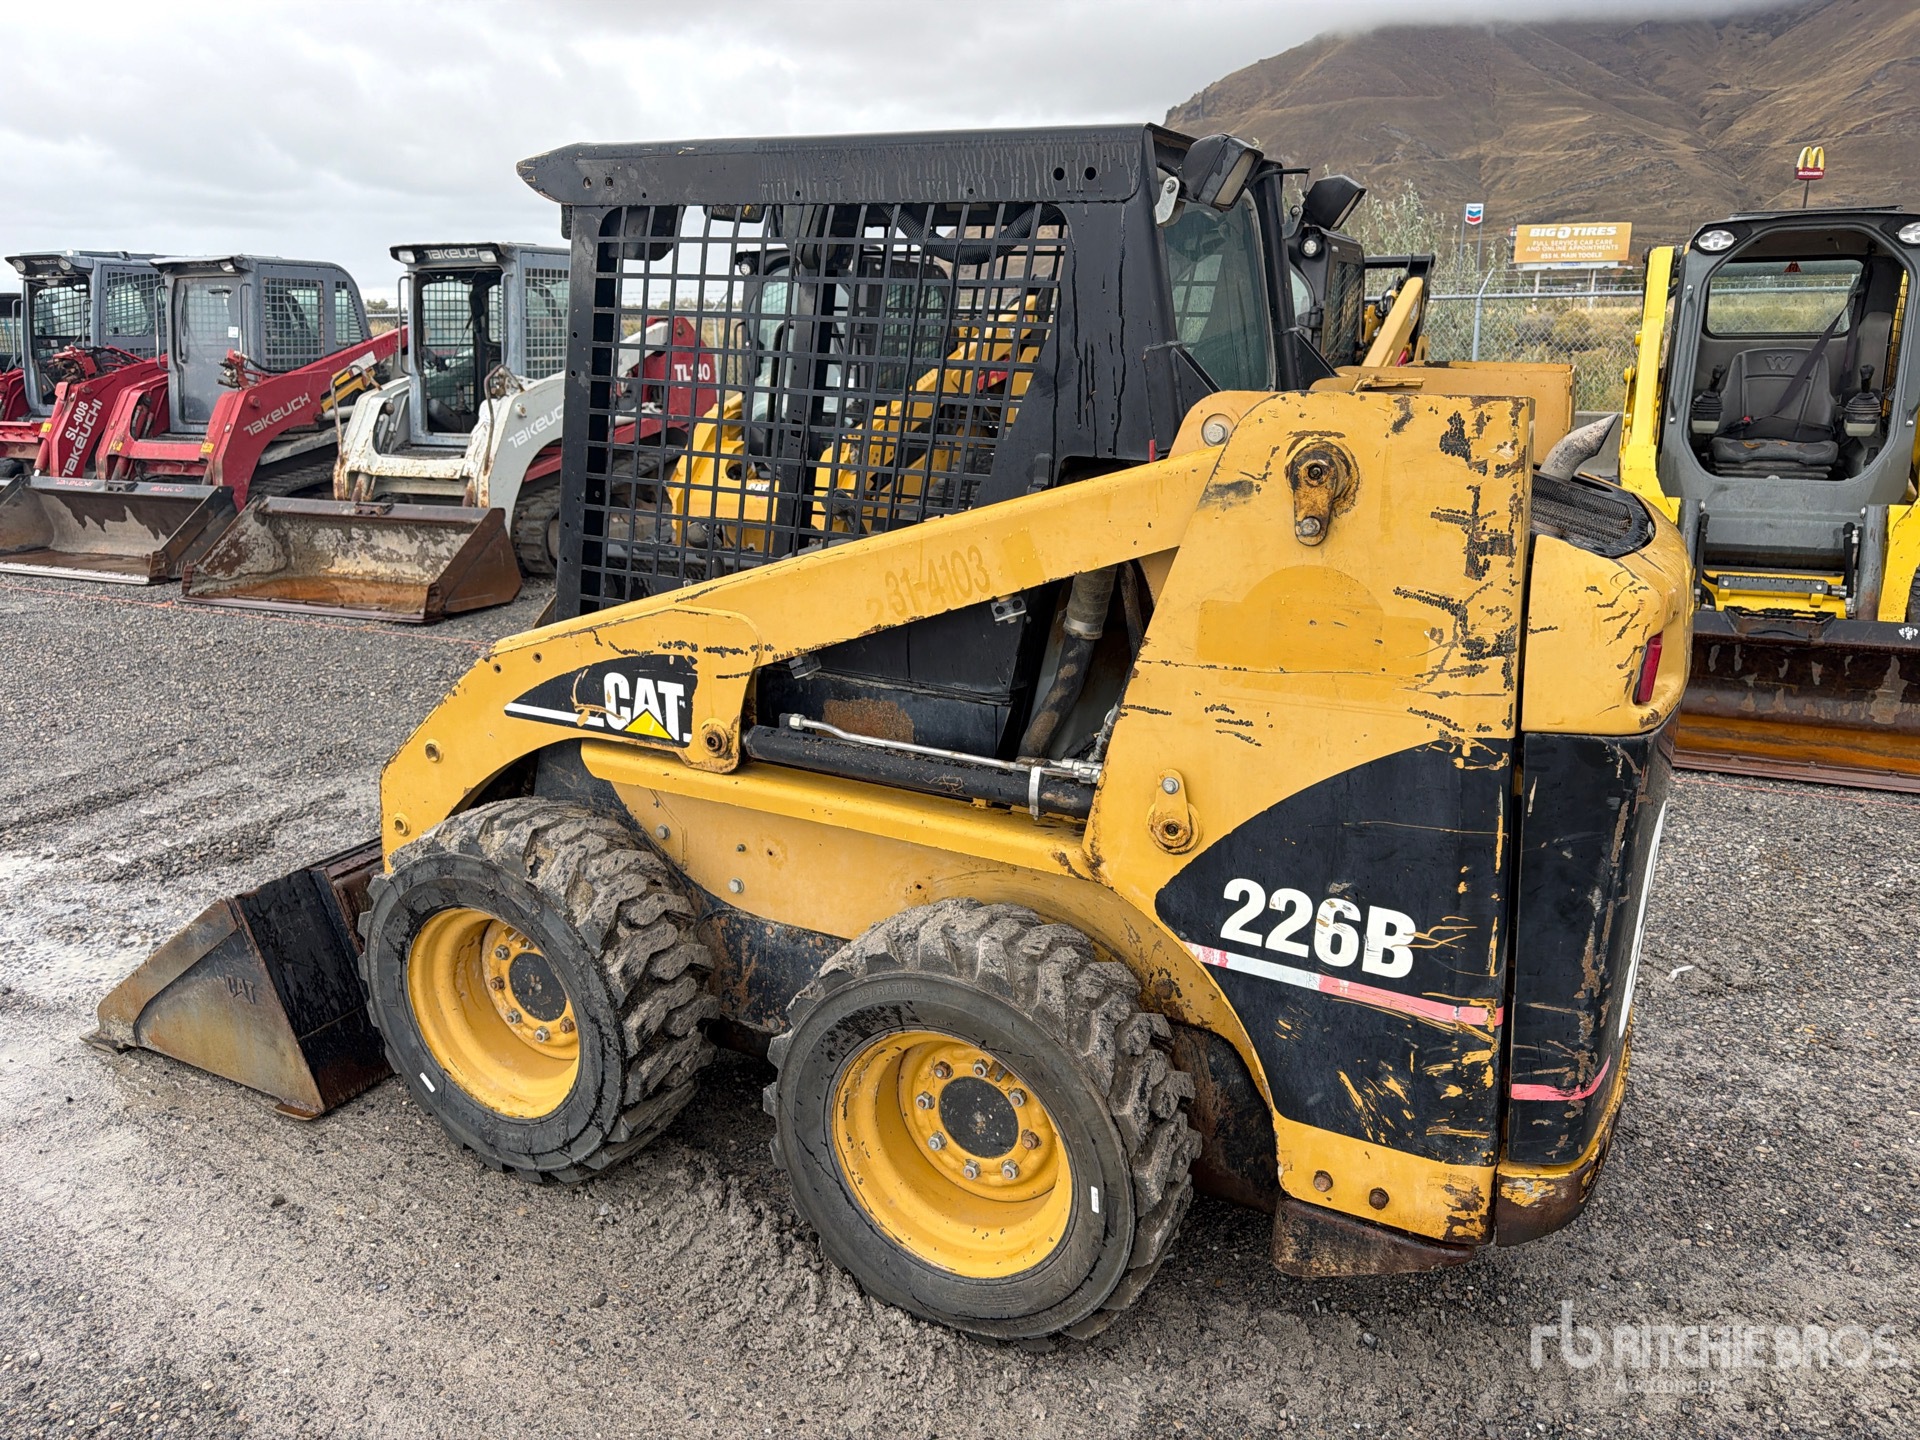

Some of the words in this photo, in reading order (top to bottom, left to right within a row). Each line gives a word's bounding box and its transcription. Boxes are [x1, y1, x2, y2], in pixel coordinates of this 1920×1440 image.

[1529, 227, 1557, 237] BIG
[1572, 226, 1617, 237] TIRES
[1551, 239, 1578, 247] SERVICE
[424, 247, 478, 260] TAKEUC
[62, 398, 103, 477] TAKEUCHI
[65, 401, 89, 441] SL-008
[507, 404, 564, 449] TAKEUC
[603, 671, 686, 741] CAT
[1219, 877, 1417, 979] 226B
[224, 973, 256, 1004] CAT
